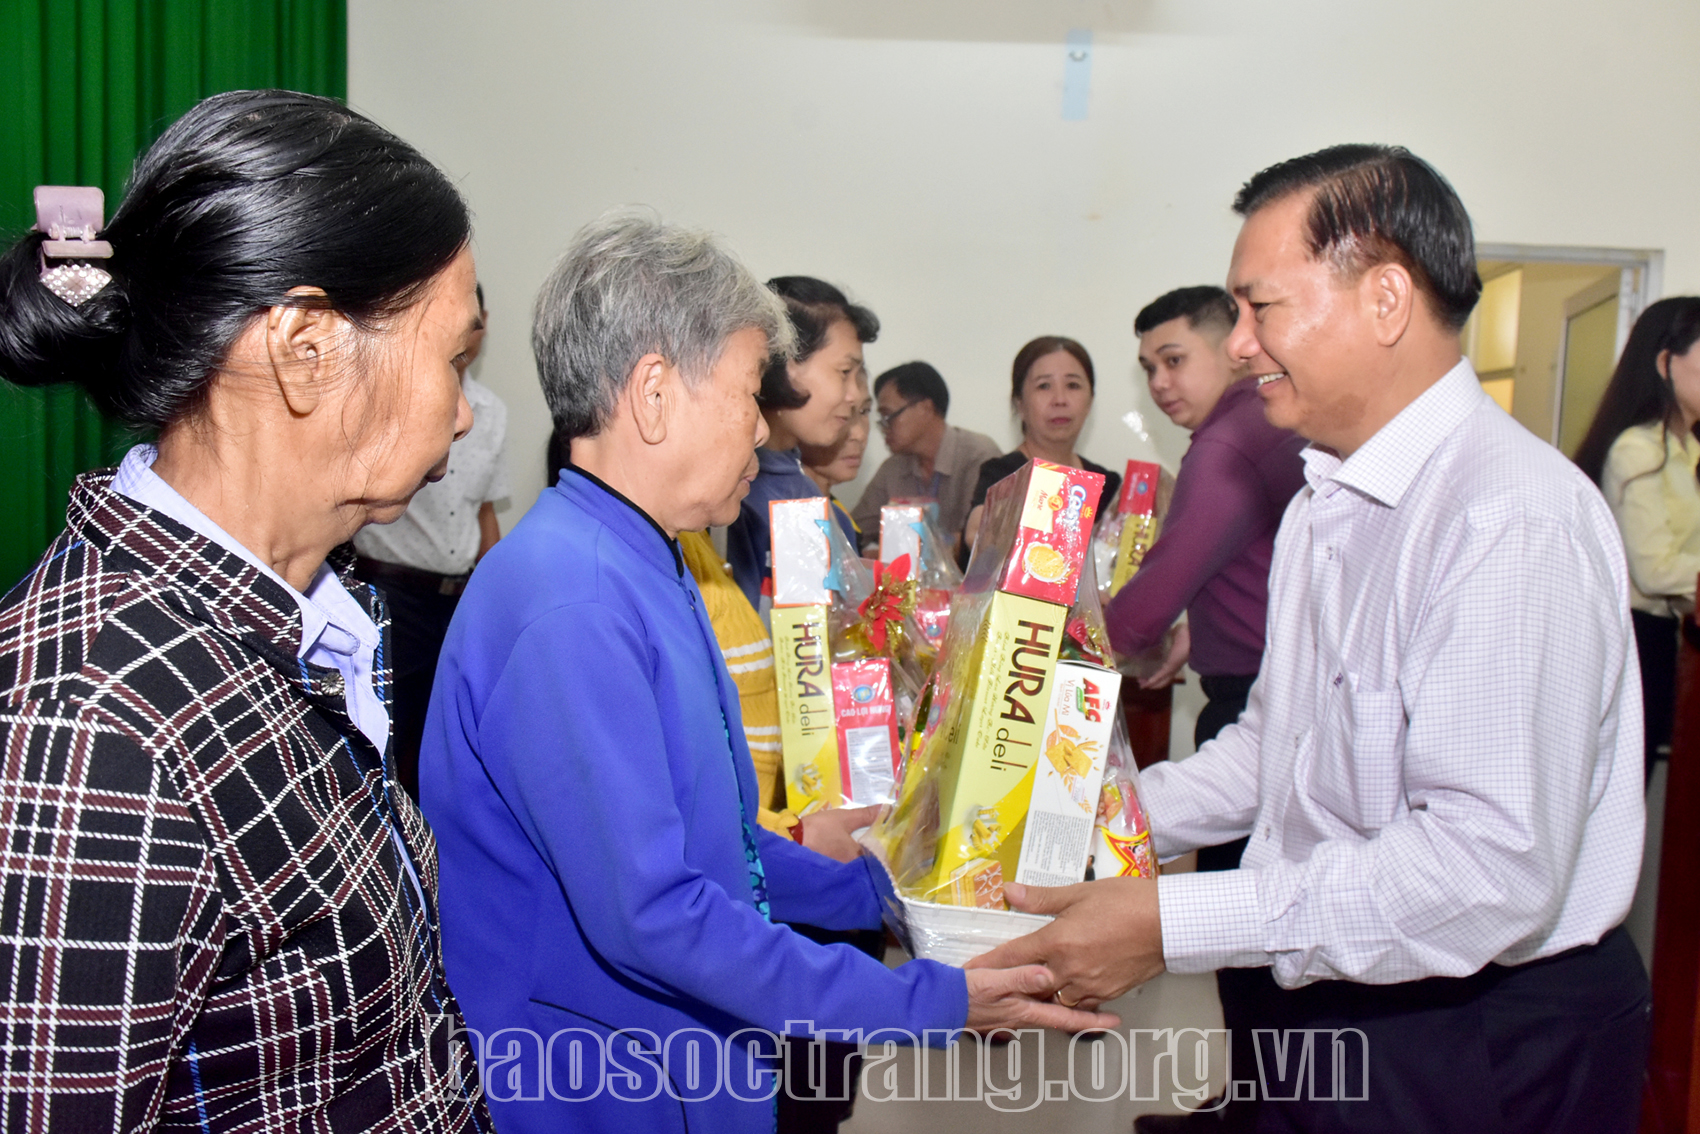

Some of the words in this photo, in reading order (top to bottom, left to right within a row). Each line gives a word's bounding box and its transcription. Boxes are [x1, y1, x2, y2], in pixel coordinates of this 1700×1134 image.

[792, 621, 826, 698] HURA
[1000, 619, 1055, 725] HURA
[799, 703, 830, 737] deli
[1083, 677, 1102, 723] AFC
[990, 727, 1032, 771] deli
